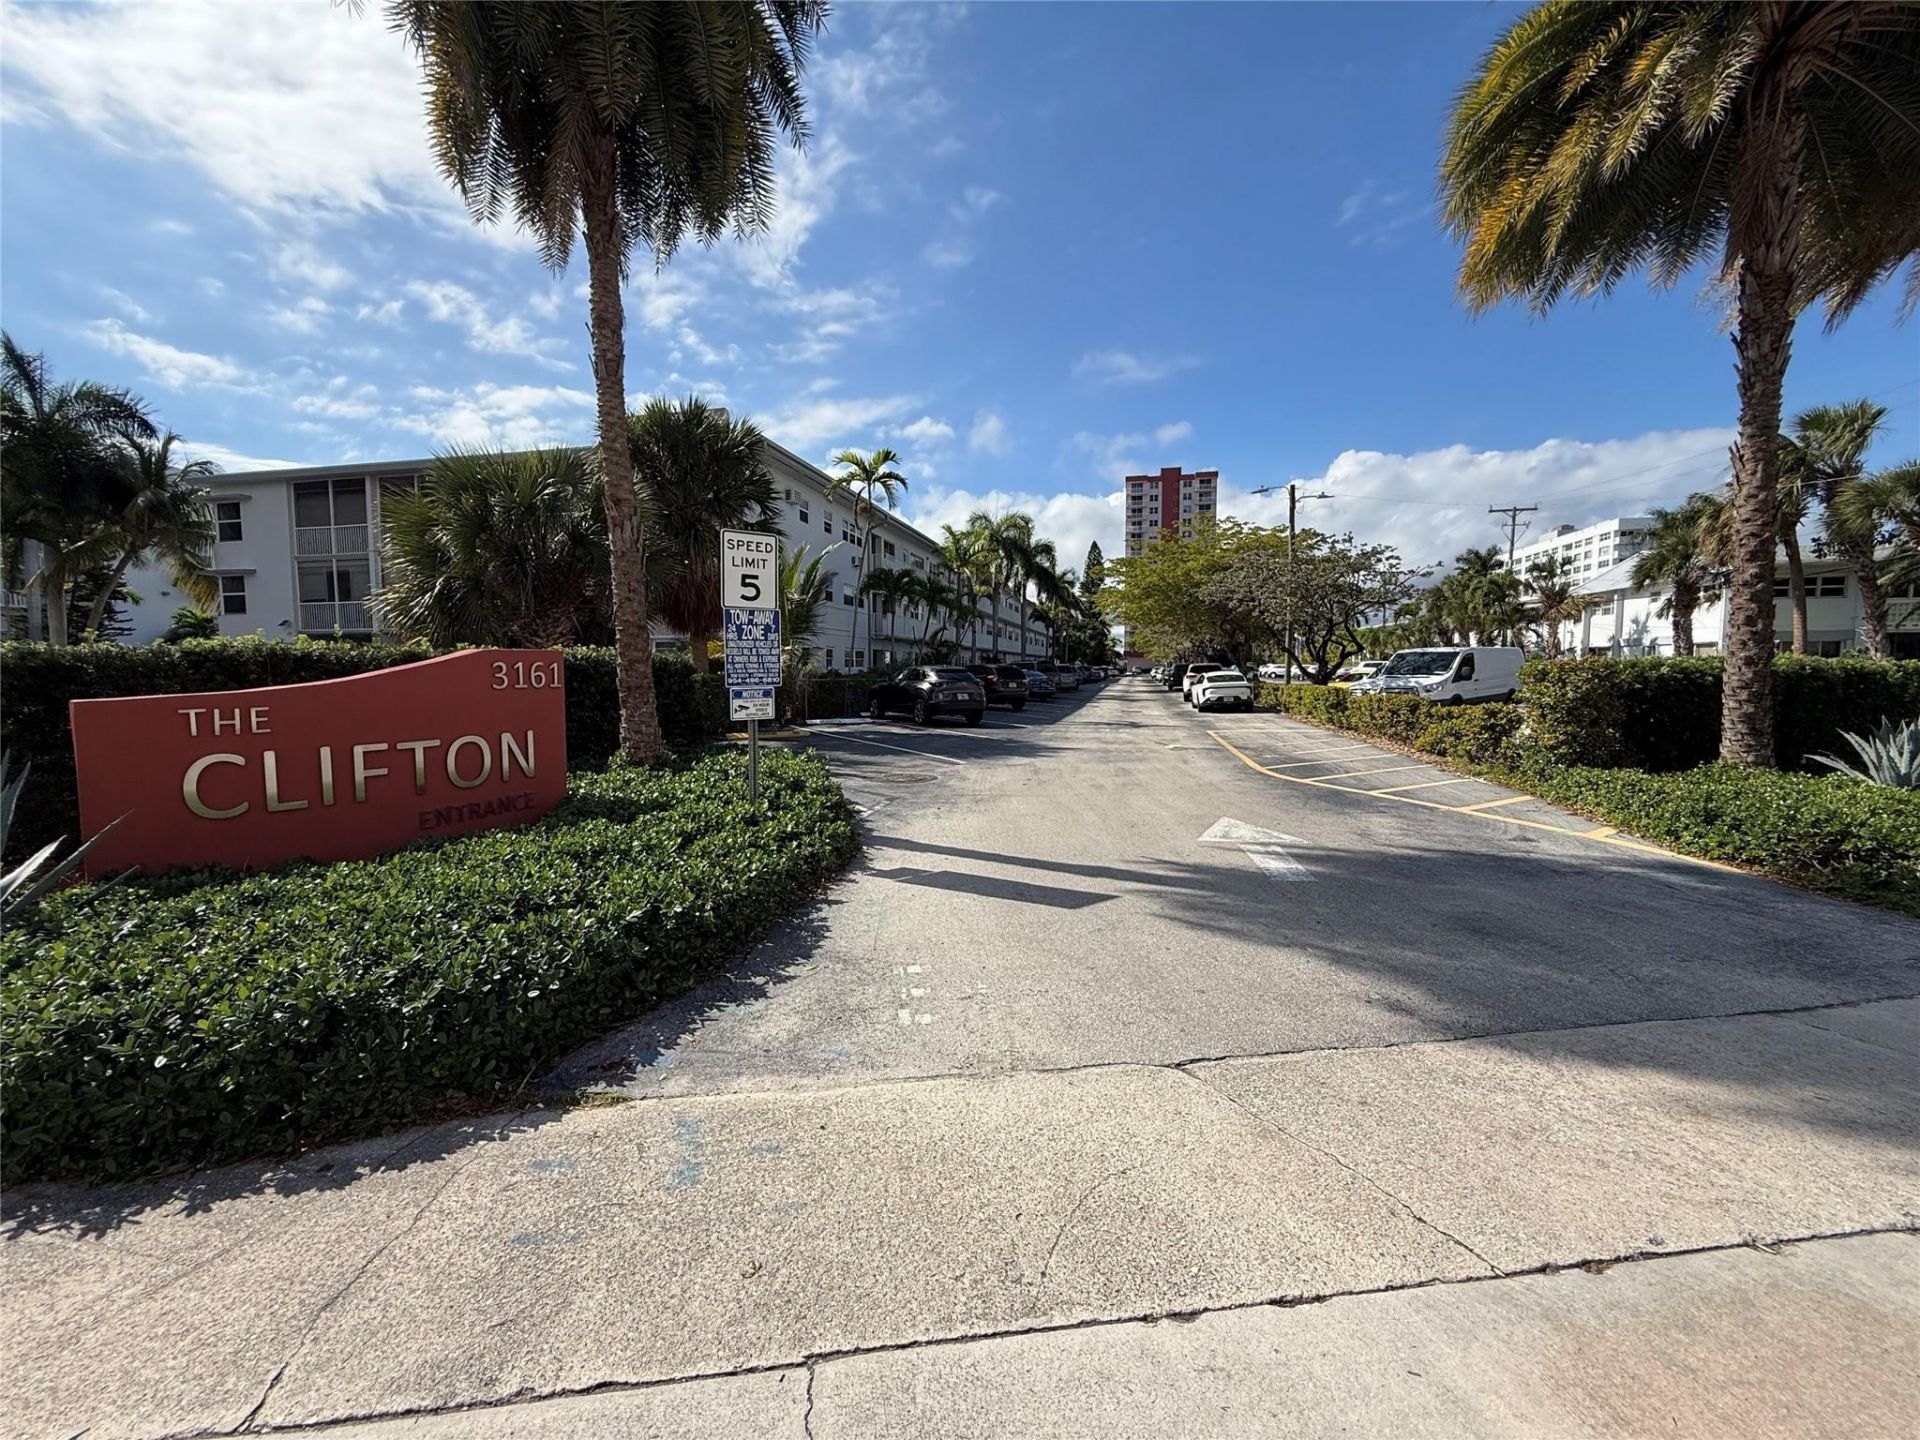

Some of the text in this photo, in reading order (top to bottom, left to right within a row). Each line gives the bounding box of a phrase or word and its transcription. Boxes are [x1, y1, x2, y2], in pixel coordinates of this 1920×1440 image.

[727, 539, 773, 553] SPEED
[732, 556, 768, 569] LIMIT
[740, 573, 761, 601] 5
[729, 609, 775, 625] TOW-AWAY
[727, 623, 736, 633] 24
[741, 624, 765, 640] ZONE
[771, 624, 776, 633] 7
[490, 660, 563, 690] 3161
[177, 706, 272, 737] THE
[182, 729, 536, 820] CLIFTON
[418, 792, 537, 830] ENTRANCE
